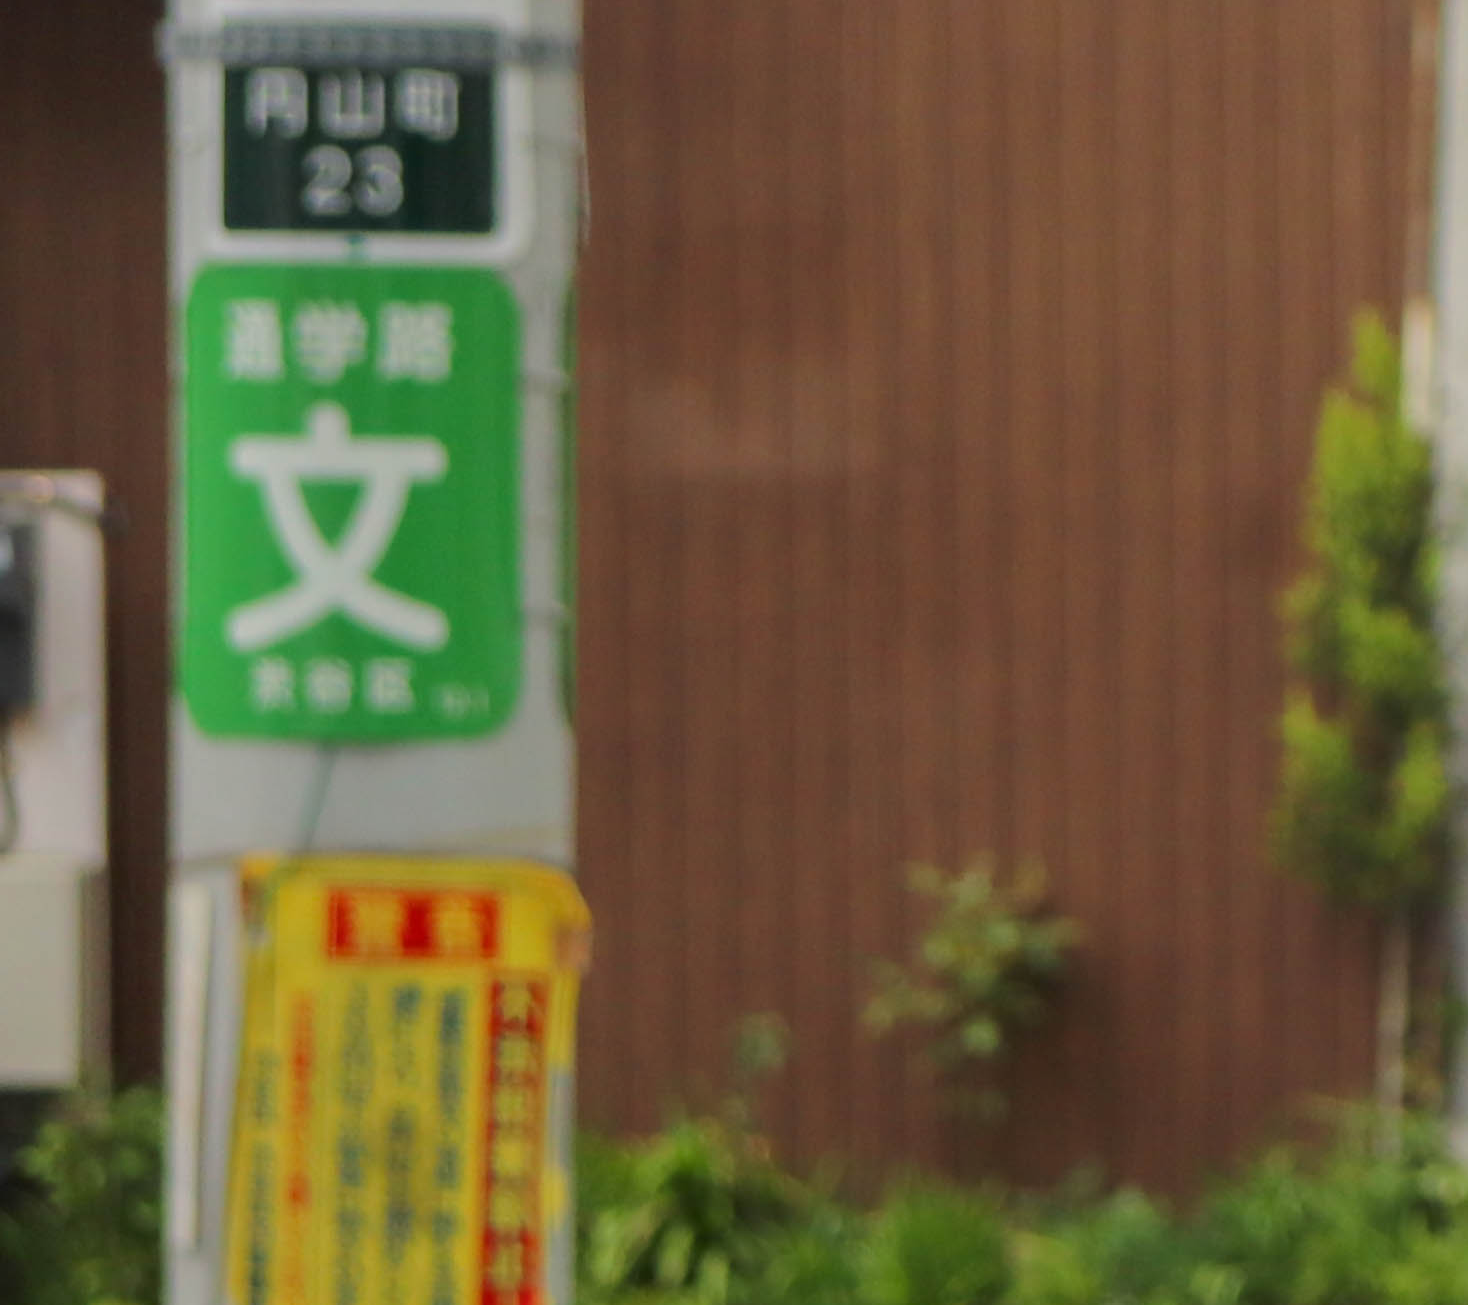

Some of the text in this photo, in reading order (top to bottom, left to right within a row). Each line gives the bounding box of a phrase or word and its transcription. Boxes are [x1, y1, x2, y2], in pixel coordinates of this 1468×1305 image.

[243, 67, 460, 140] 円山町
[302, 144, 404, 217] 23
[225, 401, 451, 651] 文
